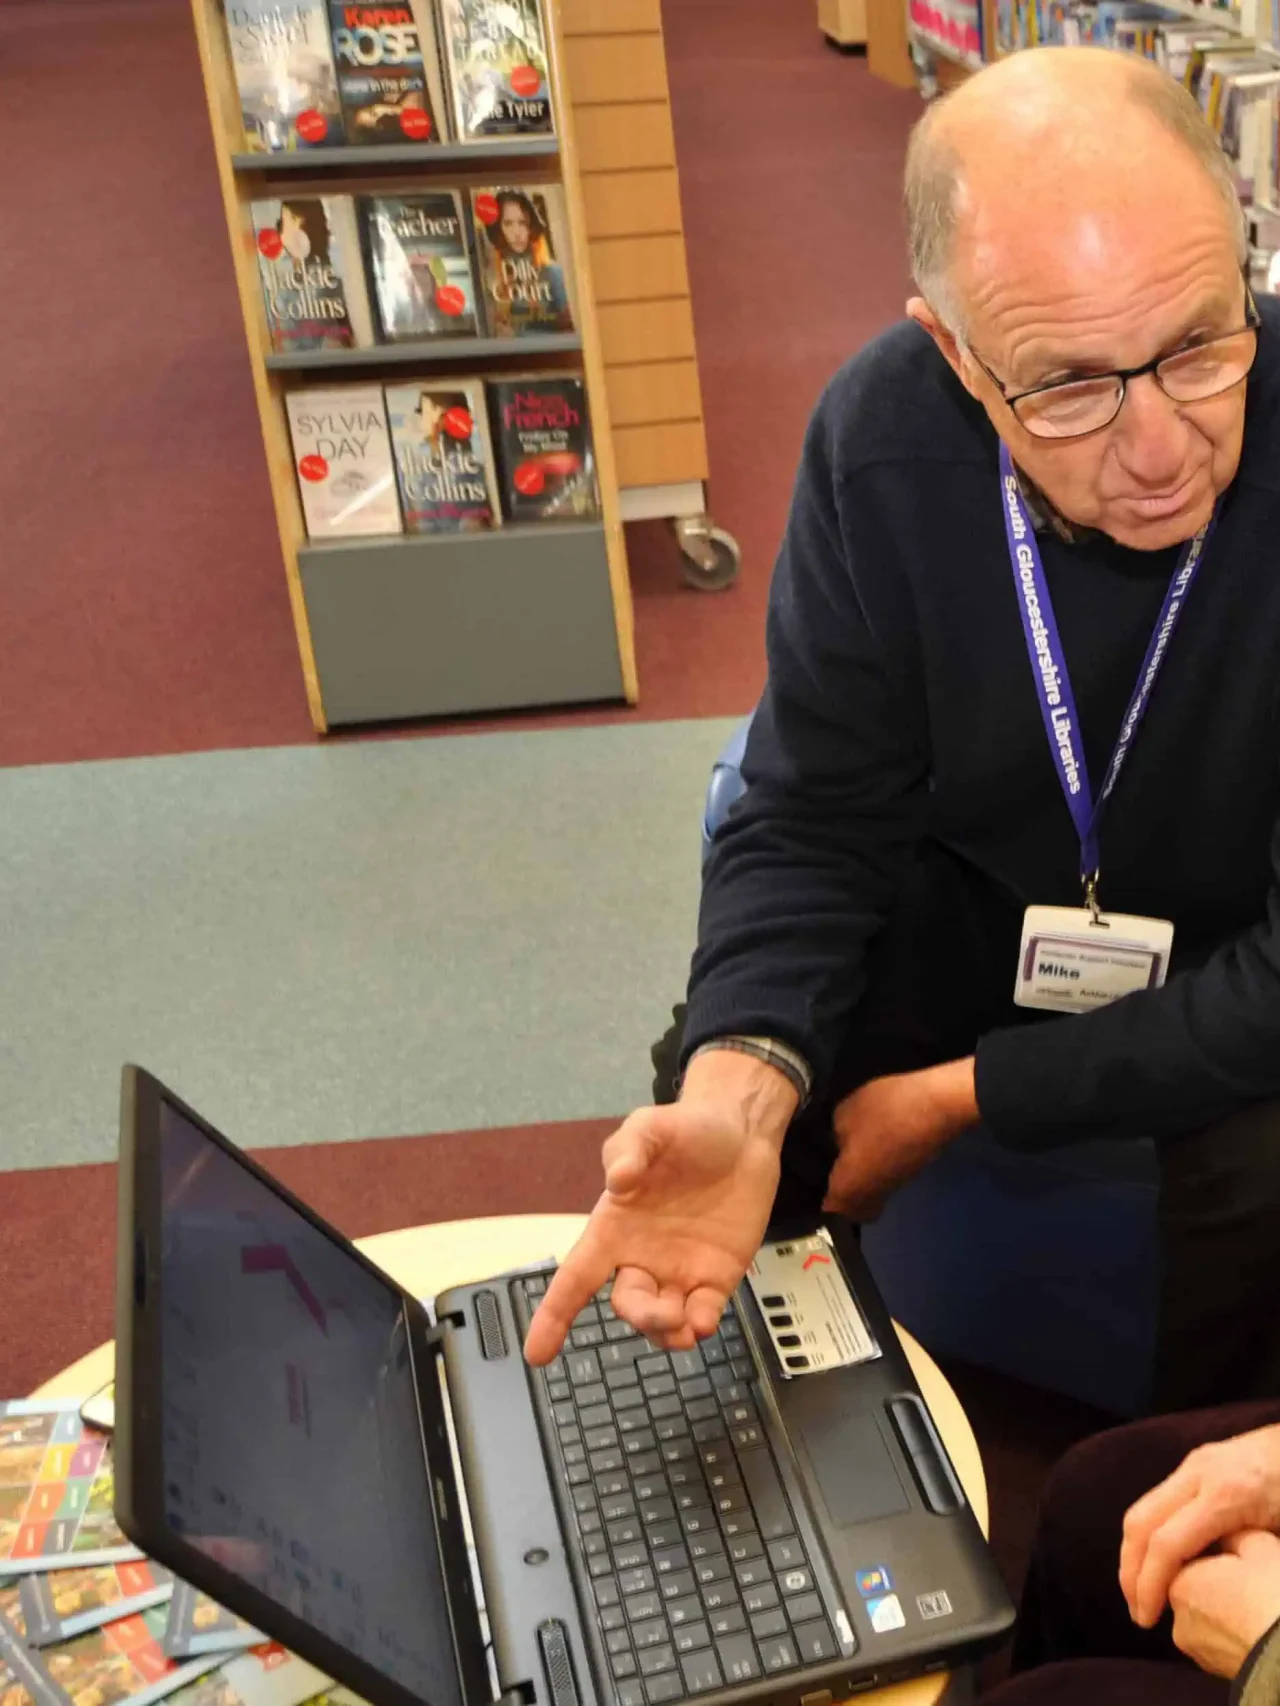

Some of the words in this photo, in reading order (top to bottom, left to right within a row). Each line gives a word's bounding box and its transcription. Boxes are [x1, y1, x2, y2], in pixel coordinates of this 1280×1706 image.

[335, 22, 423, 67] ROSE
[506, 100, 544, 120] Tyler
[266, 255, 338, 293] Jackie
[270, 289, 346, 319] Collins
[297, 411, 382, 437] SYLVIA
[315, 435, 371, 461] DAY
[401, 433, 479, 478] Jackie
[404, 474, 486, 501] Collins
[1005, 475, 1027, 539] South
[1016, 543, 1061, 705] Gloucestershire
[1051, 706, 1081, 795] Libraries
[1038, 962, 1080, 980] Mike
